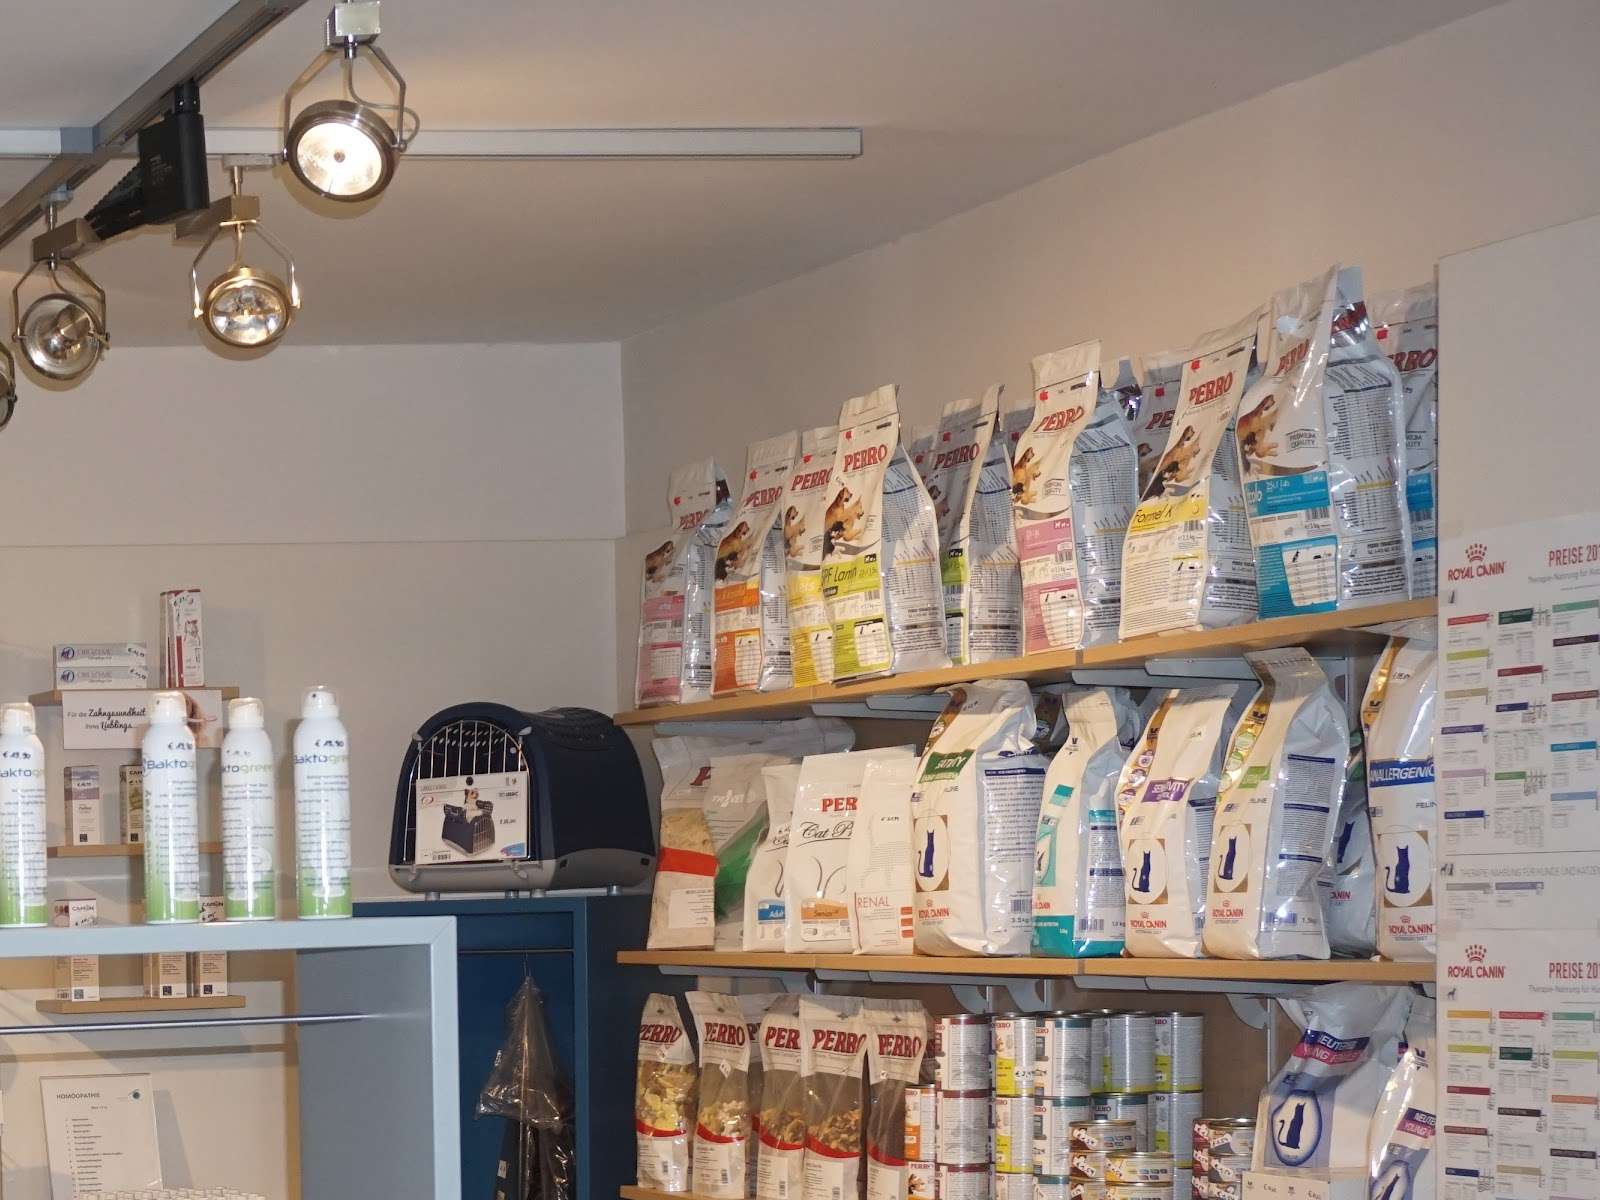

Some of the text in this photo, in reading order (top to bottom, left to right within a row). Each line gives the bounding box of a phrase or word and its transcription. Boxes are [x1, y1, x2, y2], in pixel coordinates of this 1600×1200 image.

[1189, 371, 1233, 406] PERRO
[1033, 406, 1085, 433] PERRO
[843, 444, 888, 473] PERRO
[934, 443, 981, 470] PERRO
[744, 486, 784, 508] PERRO
[1548, 547, 1584, 567] PREISE
[1447, 561, 1506, 582] ROYAL CANIN
[88, 708, 147, 721] Zahngesundheit
[801, 820, 830, 840] Cat
[857, 896, 890, 909] RENAL
[1407, 923, 1433, 934] CANIN
[1447, 964, 1505, 979] ROYAL CANIN
[1549, 962, 1584, 979] PREISE
[639, 1024, 682, 1044] PERRO
[703, 1022, 746, 1046] PERRO
[878, 1033, 921, 1057] PERRO
